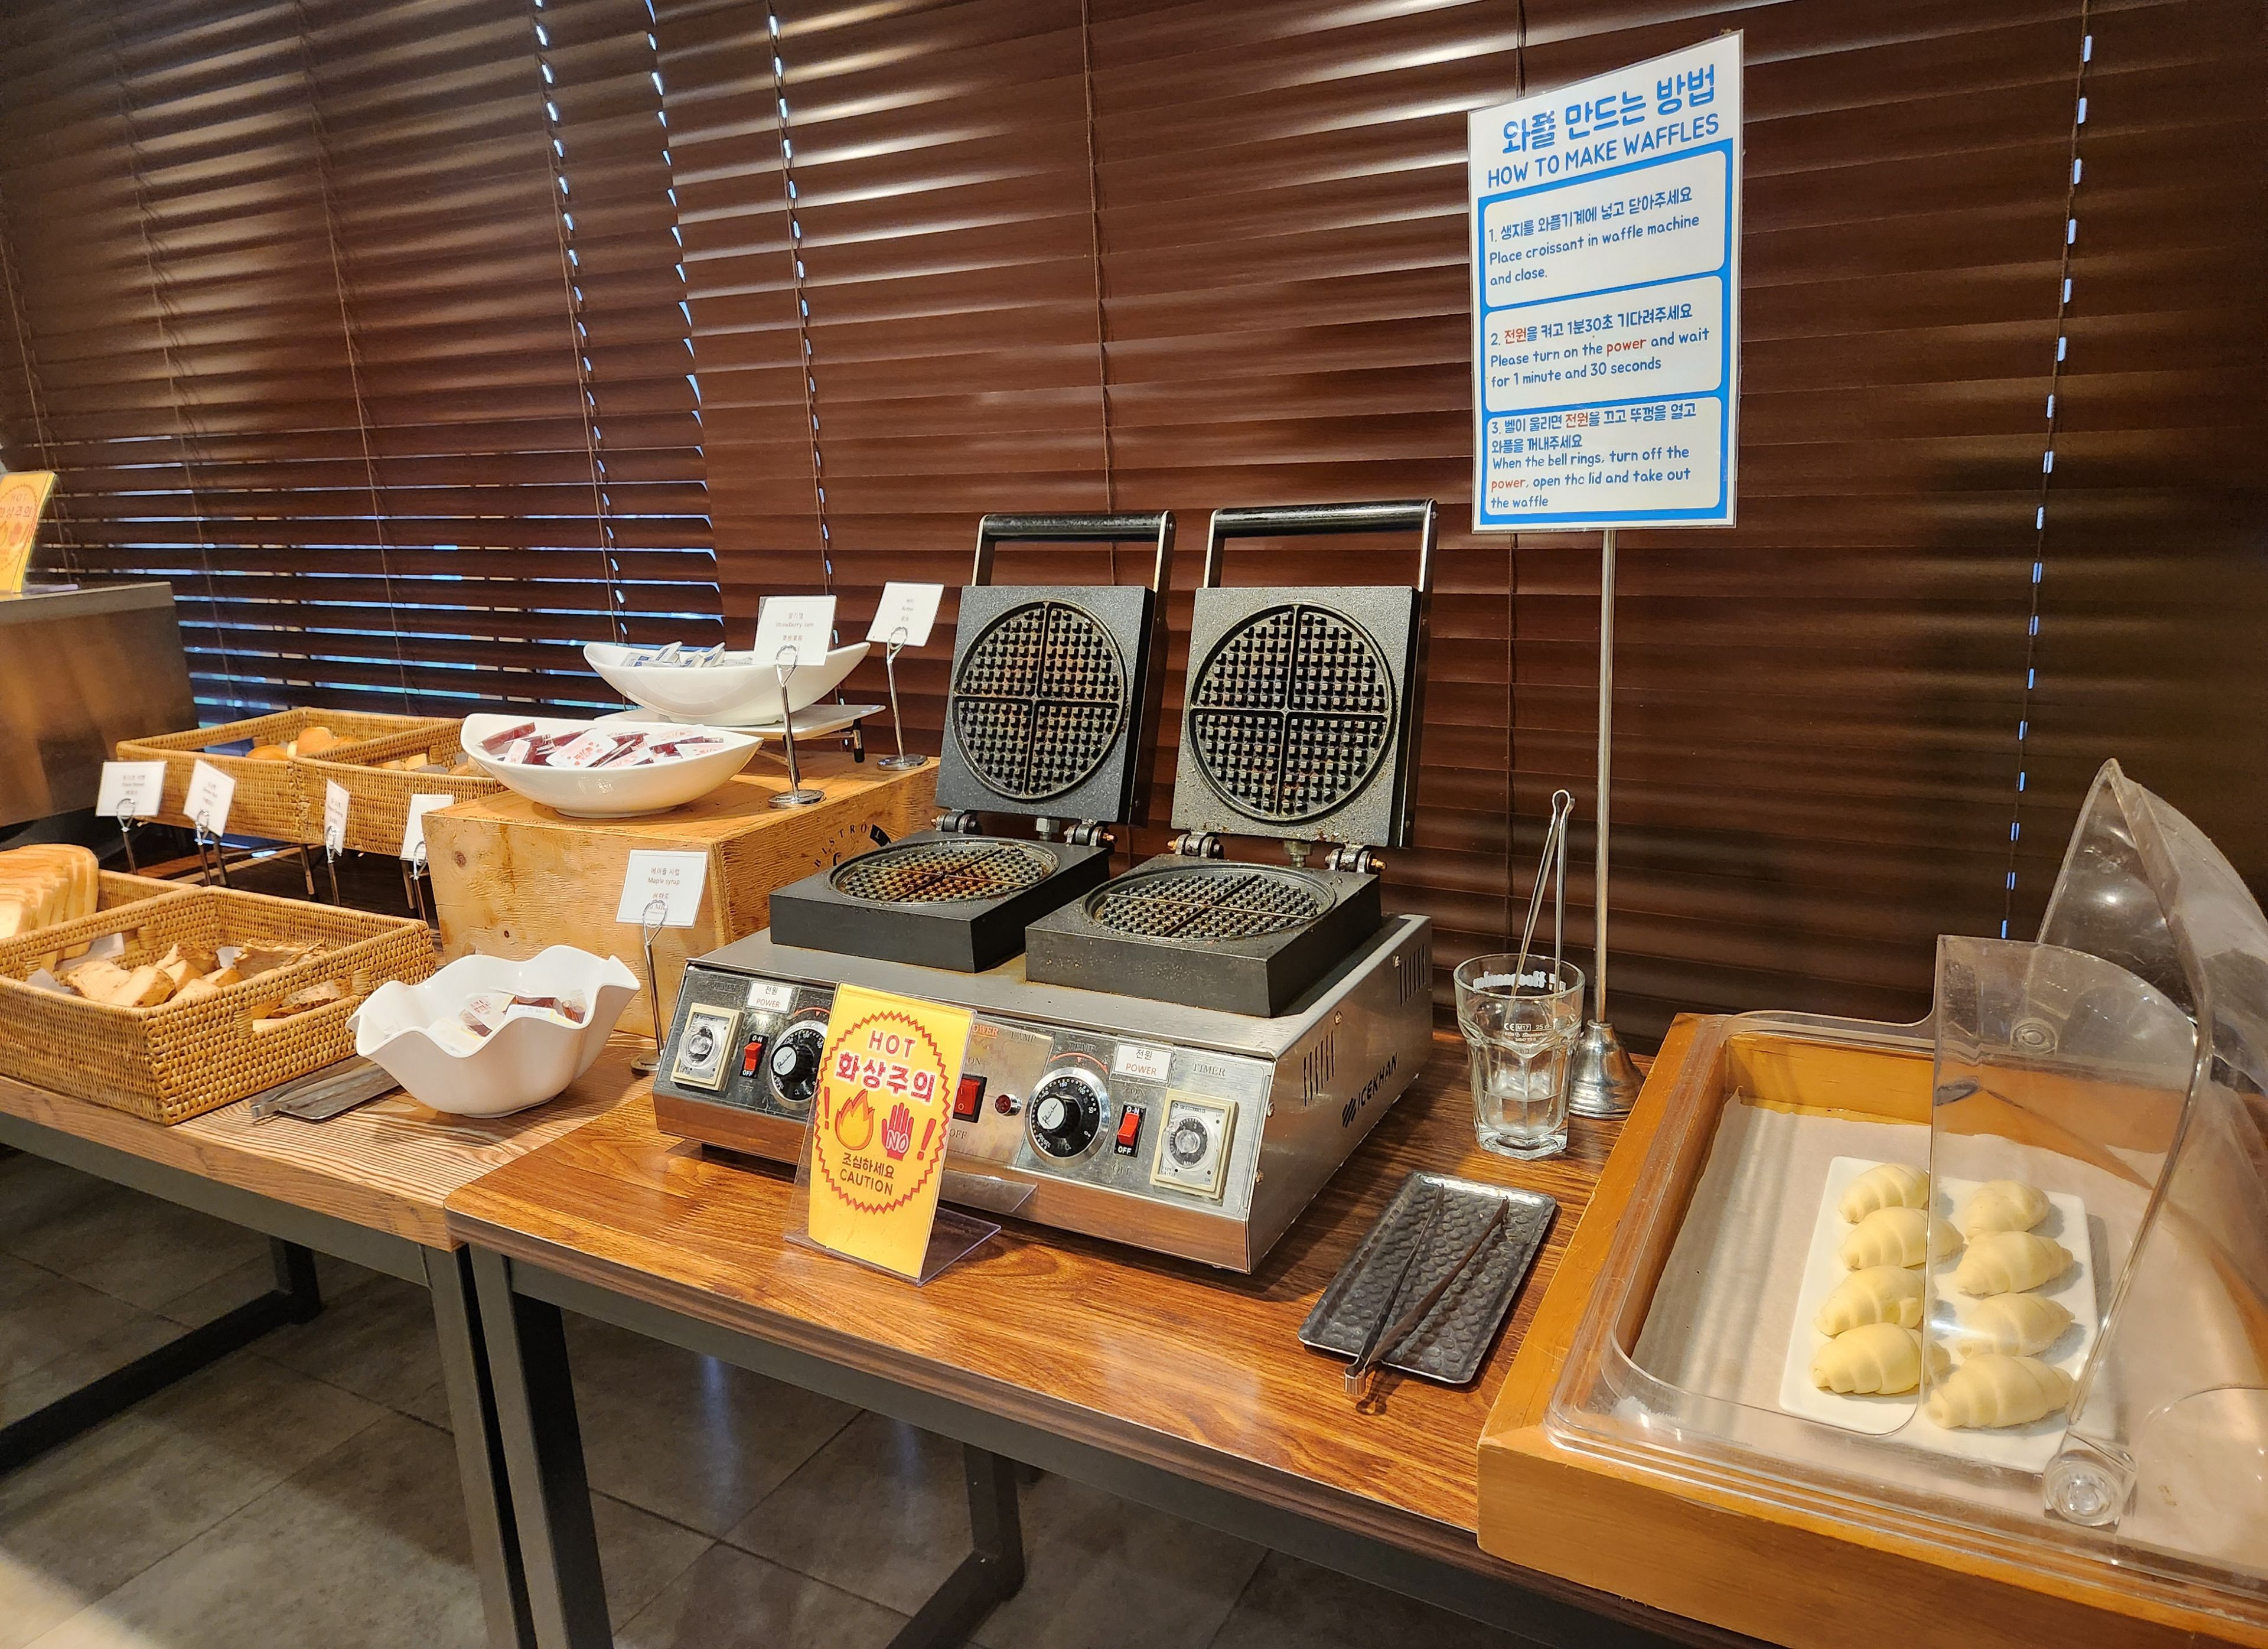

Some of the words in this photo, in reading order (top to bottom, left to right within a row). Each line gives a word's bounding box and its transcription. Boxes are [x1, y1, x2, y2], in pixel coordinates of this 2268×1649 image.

[1503, 110, 1556, 154] 와플
[1565, 90, 1647, 141] 만드는
[1657, 64, 1715, 115] 방법
[1488, 162, 1529, 188] HOW
[1534, 155, 1559, 177] TO
[1565, 139, 1617, 171] MAKE
[1624, 113, 1719, 156] WAFFLES
[1488, 229, 1497, 242] 1.
[1501, 219, 1534, 240] 생지를
[1537, 206, 1596, 233] 와플기계에
[1601, 201, 1625, 220] 넣고
[1629, 186, 1693, 215] 닫아주세요
[1490, 251, 1522, 265] Place
[1526, 236, 1584, 258] croissant
[1588, 234, 1598, 247] in
[1602, 224, 1643, 244] waffle
[1647, 215, 1699, 235] machine
[1490, 271, 1511, 286] and
[1515, 268, 1547, 281] close.
[1490, 333, 1501, 346] 2.
[1504, 326, 1537, 344] 전원을
[1541, 322, 1564, 338] 켜고
[1568, 314, 1614, 335] 1분30초
[1617, 303, 1693, 327] 기다려주세요
[1491, 355, 1529, 367] Please
[1533, 351, 1560, 363] turn
[1563, 347, 1578, 359] on
[1582, 342, 1603, 356] the
[1606, 338, 1647, 357] power
[1651, 331, 1674, 347] and
[1679, 327, 1710, 344] wait
[1491, 376, 1510, 388] for
[1513, 372, 1519, 385] 1
[1523, 370, 1562, 384] minute
[1565, 364, 1587, 379] and
[1591, 361, 1607, 376] 30
[1611, 356, 1661, 374] seconds
[1491, 421, 1501, 435] 3.
[1504, 418, 1526, 434] 벨이
[1529, 415, 1562, 432] 울리면
[1566, 411, 1600, 429] 전원을
[1604, 409, 1627, 424] 끄고
[1630, 405, 1666, 423] 뚜껑을
[1671, 403, 1696, 420] 열고
[1491, 438, 1524, 454] 와플을
[1527, 434, 1582, 452] 꺼내주세요
[1493, 457, 1521, 470] When
[1525, 455, 1544, 467] the
[1548, 452, 1567, 467] bell
[1570, 452, 1605, 467] rings,
[1609, 450, 1638, 462] turn
[1642, 447, 1663, 461] off
[1667, 445, 1689, 459] the
[1491, 479, 1529, 493] power,
[1533, 476, 1560, 491] open
[1588, 471, 1602, 484] lid
[1605, 470, 1629, 483] and
[1633, 468, 1663, 482] take
[1667, 467, 1691, 480] out
[10, 493, 27, 502] HOT
[1491, 496, 1509, 509] the
[1513, 495, 1549, 508] waffle
[647, 877, 664, 886] Maple
[765, 986, 778, 996] 전원
[756, 999, 780, 1008] POWER
[868, 1030, 915, 1058] HOT
[972, 1024, 999, 1036] OWER
[1011, 1031, 1037, 1042] LAMP
[967, 1057, 981, 1065] ON
[1136, 1049, 1153, 1060] 전원
[836, 1052, 936, 1102] 화상주의
[1125, 1063, 1156, 1076] POWER
[1192, 1063, 1226, 1077] TIMER
[1357, 1051, 1398, 1112] ICEKHAN
[887, 1129, 909, 1152] NO
[949, 1129, 967, 1139] OFF
[1117, 1146, 1132, 1154] OFF
[842, 1152, 895, 1179] 조심하세요
[840, 1168, 894, 1196] CAUTION
